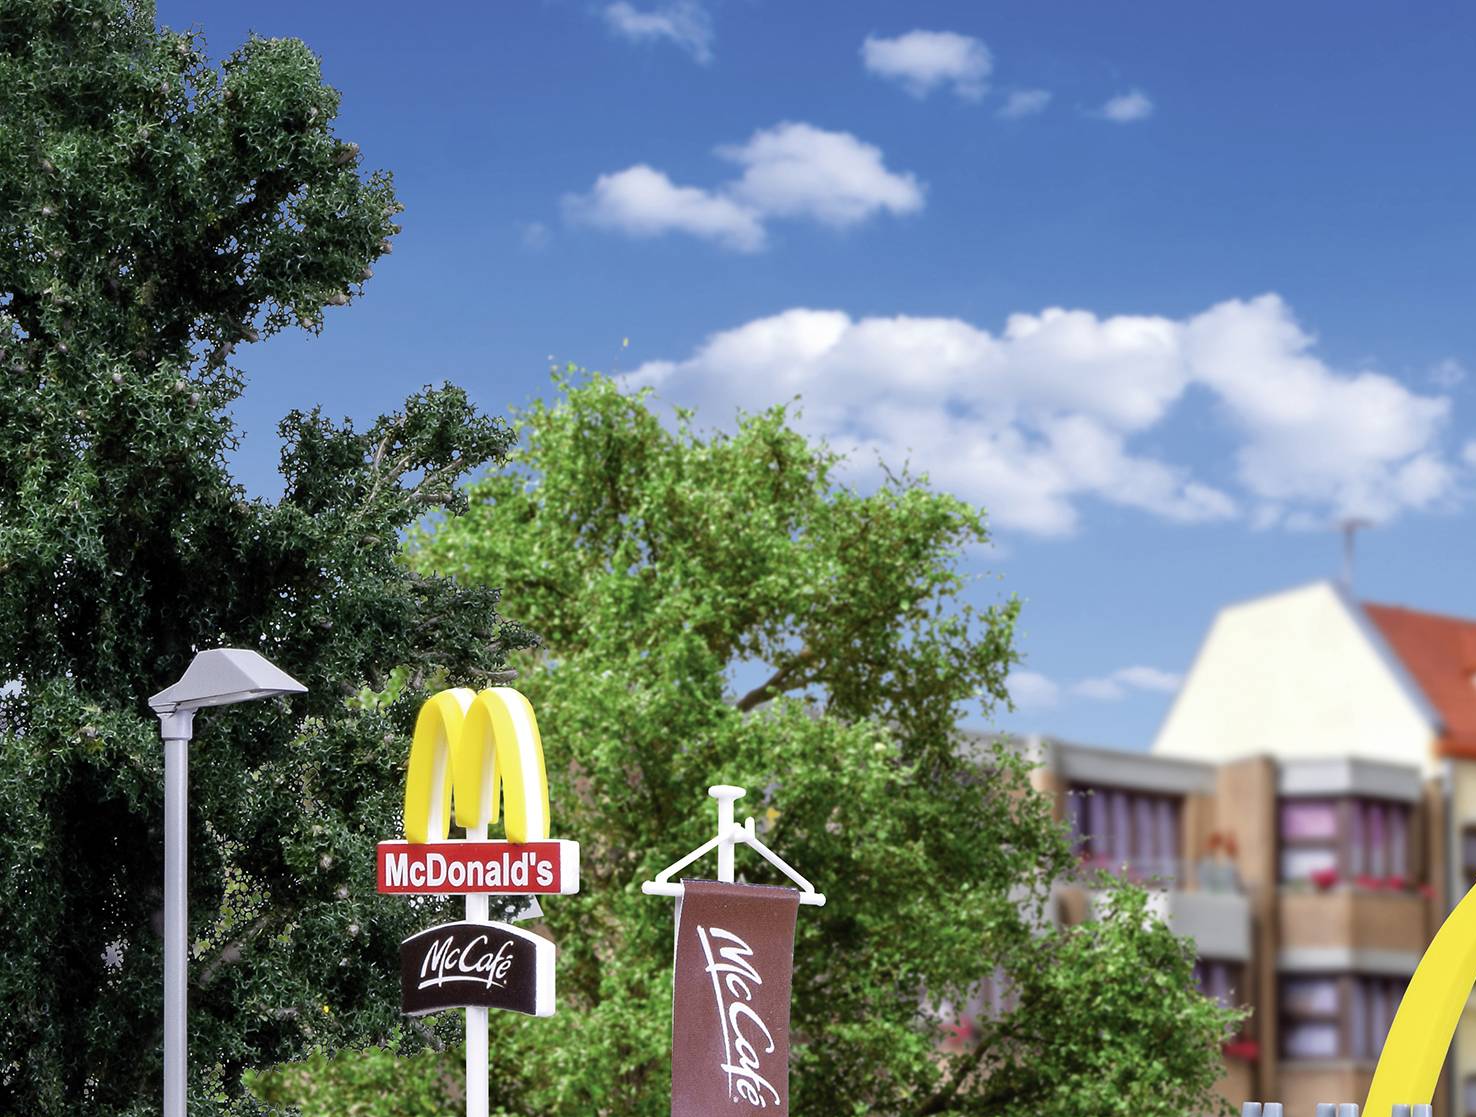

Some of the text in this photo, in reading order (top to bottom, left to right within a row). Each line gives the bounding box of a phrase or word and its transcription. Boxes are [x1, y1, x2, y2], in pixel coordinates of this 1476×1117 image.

[385, 852, 554, 888] McDonald's
[419, 935, 513, 989] McCafé
[698, 926, 781, 1108] McCafé
